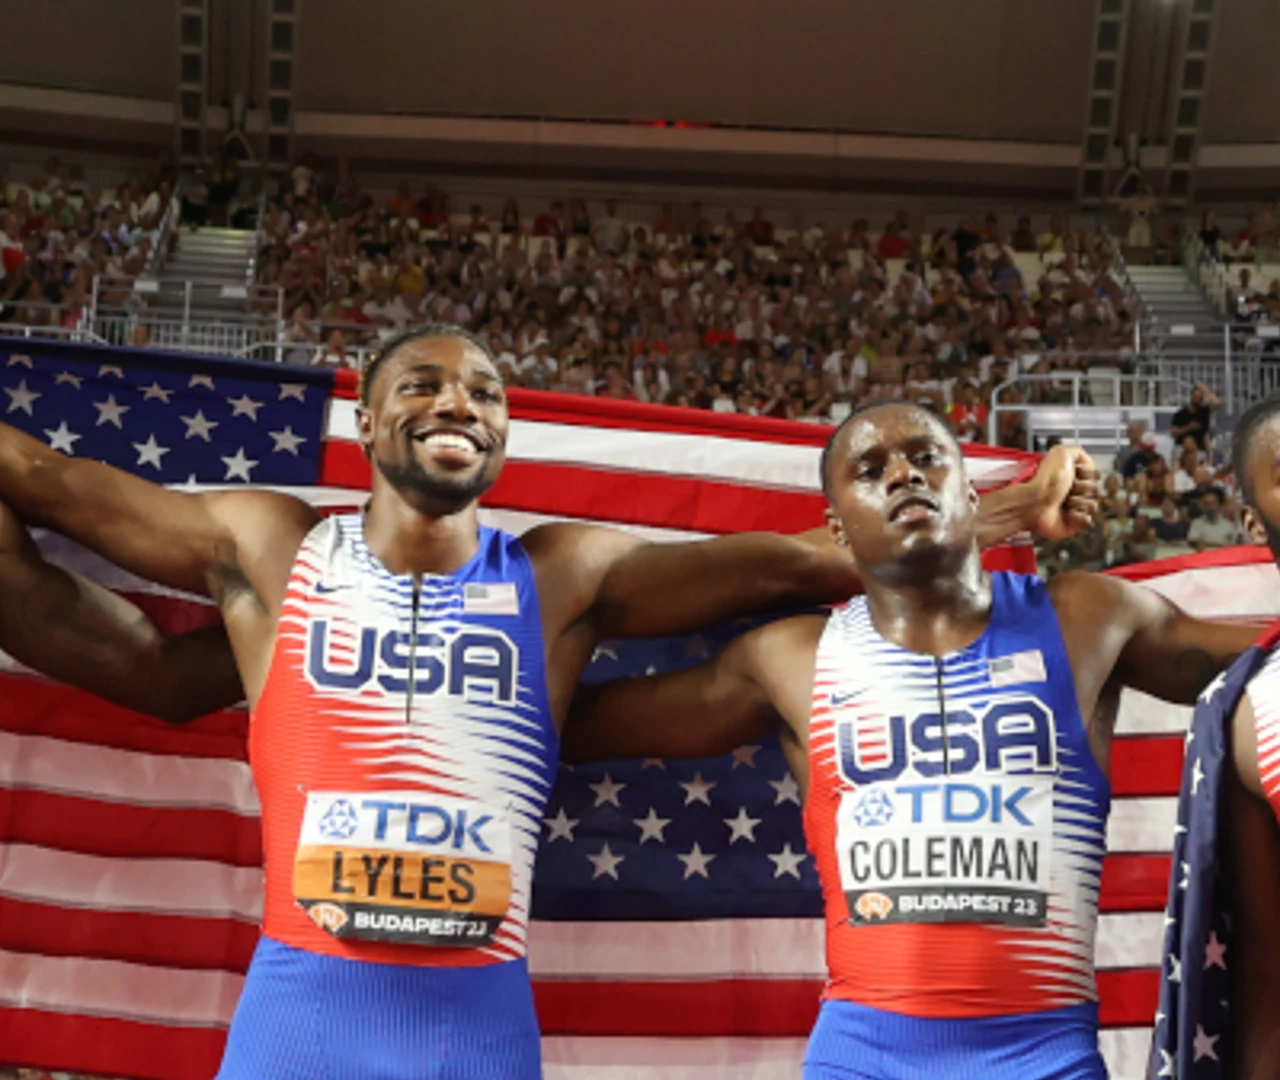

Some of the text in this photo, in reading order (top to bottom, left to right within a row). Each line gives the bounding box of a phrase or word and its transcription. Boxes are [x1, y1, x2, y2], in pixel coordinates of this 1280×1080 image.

[307, 619, 517, 702] USA
[838, 701, 1054, 785] USA
[361, 799, 495, 853] TDK
[894, 783, 1035, 827] TDK
[331, 851, 477, 904] LYLES
[849, 836, 1038, 883] COLEMAN
[354, 910, 466, 936] BUDAPEST
[898, 894, 1012, 914] BUDAPEST
